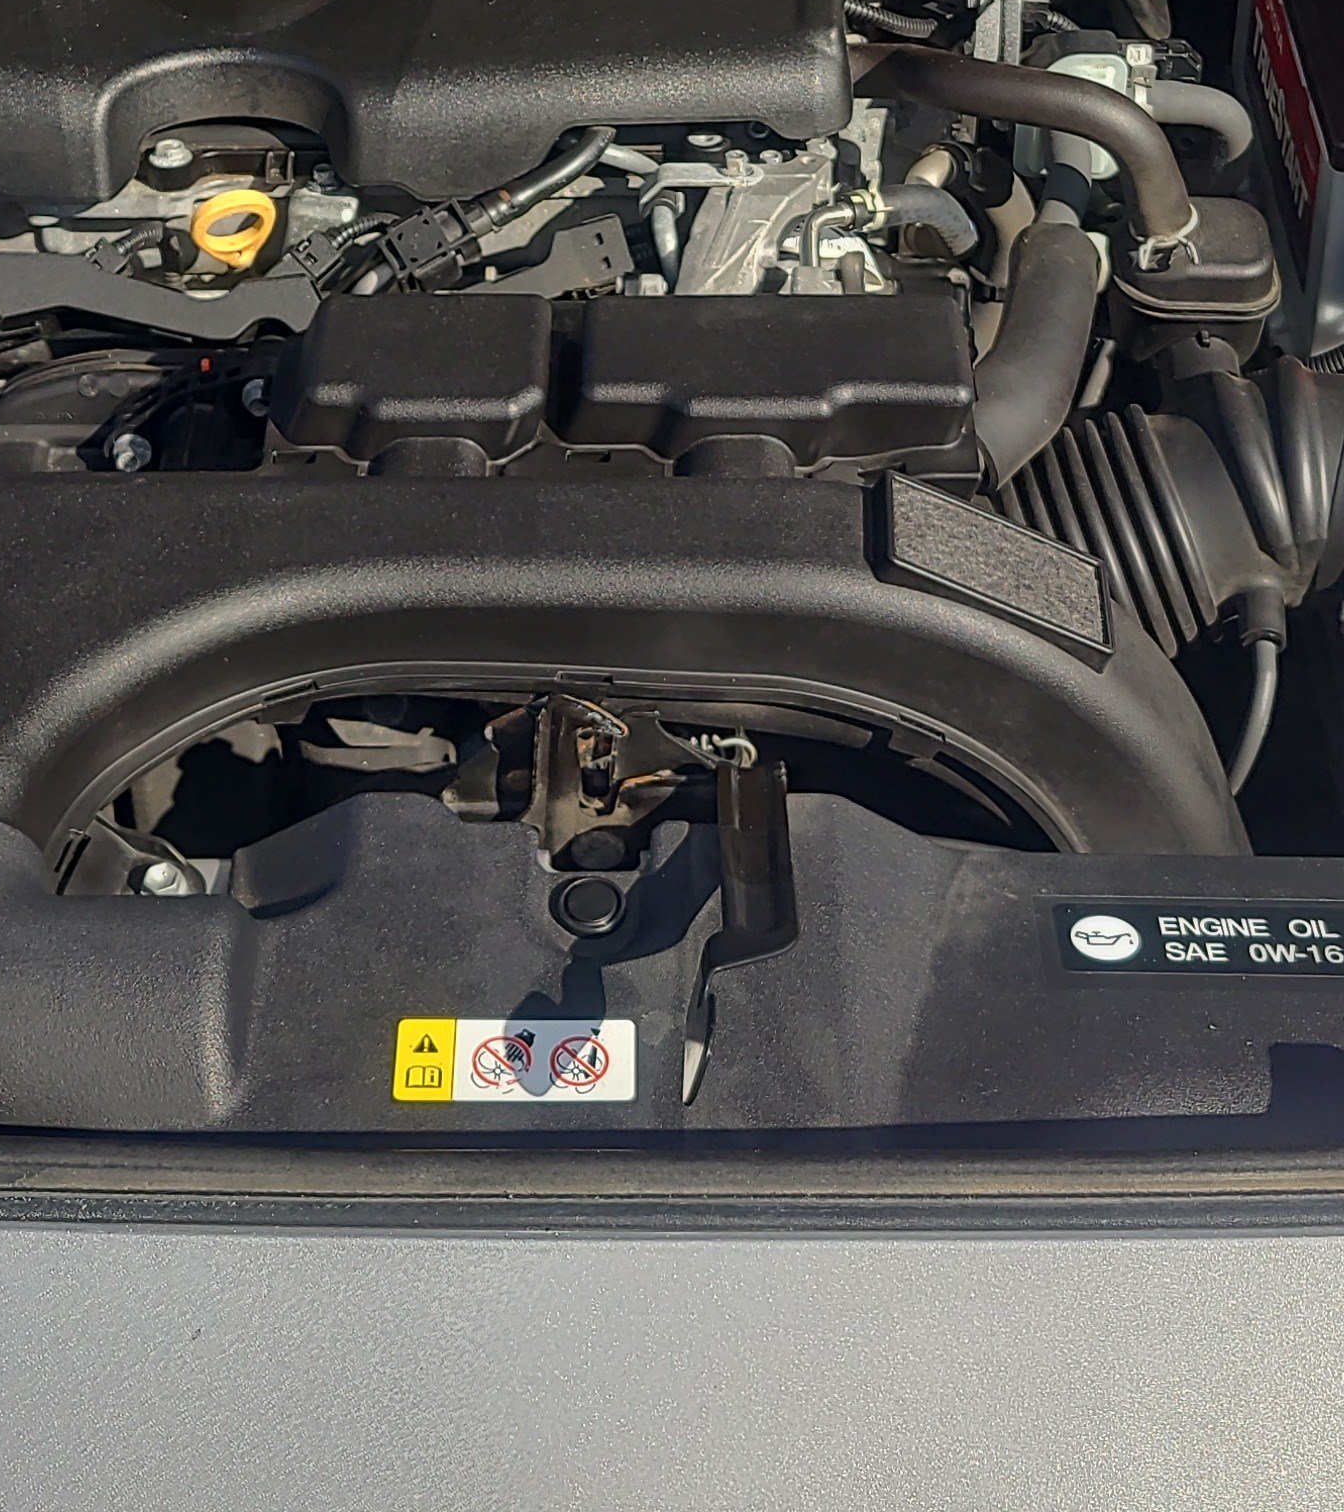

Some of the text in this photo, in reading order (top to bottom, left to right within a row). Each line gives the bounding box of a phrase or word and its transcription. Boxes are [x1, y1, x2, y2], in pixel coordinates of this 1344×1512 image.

[1157, 916, 1342, 939] ENGINE OIL
[1165, 941, 1230, 963] SAE
